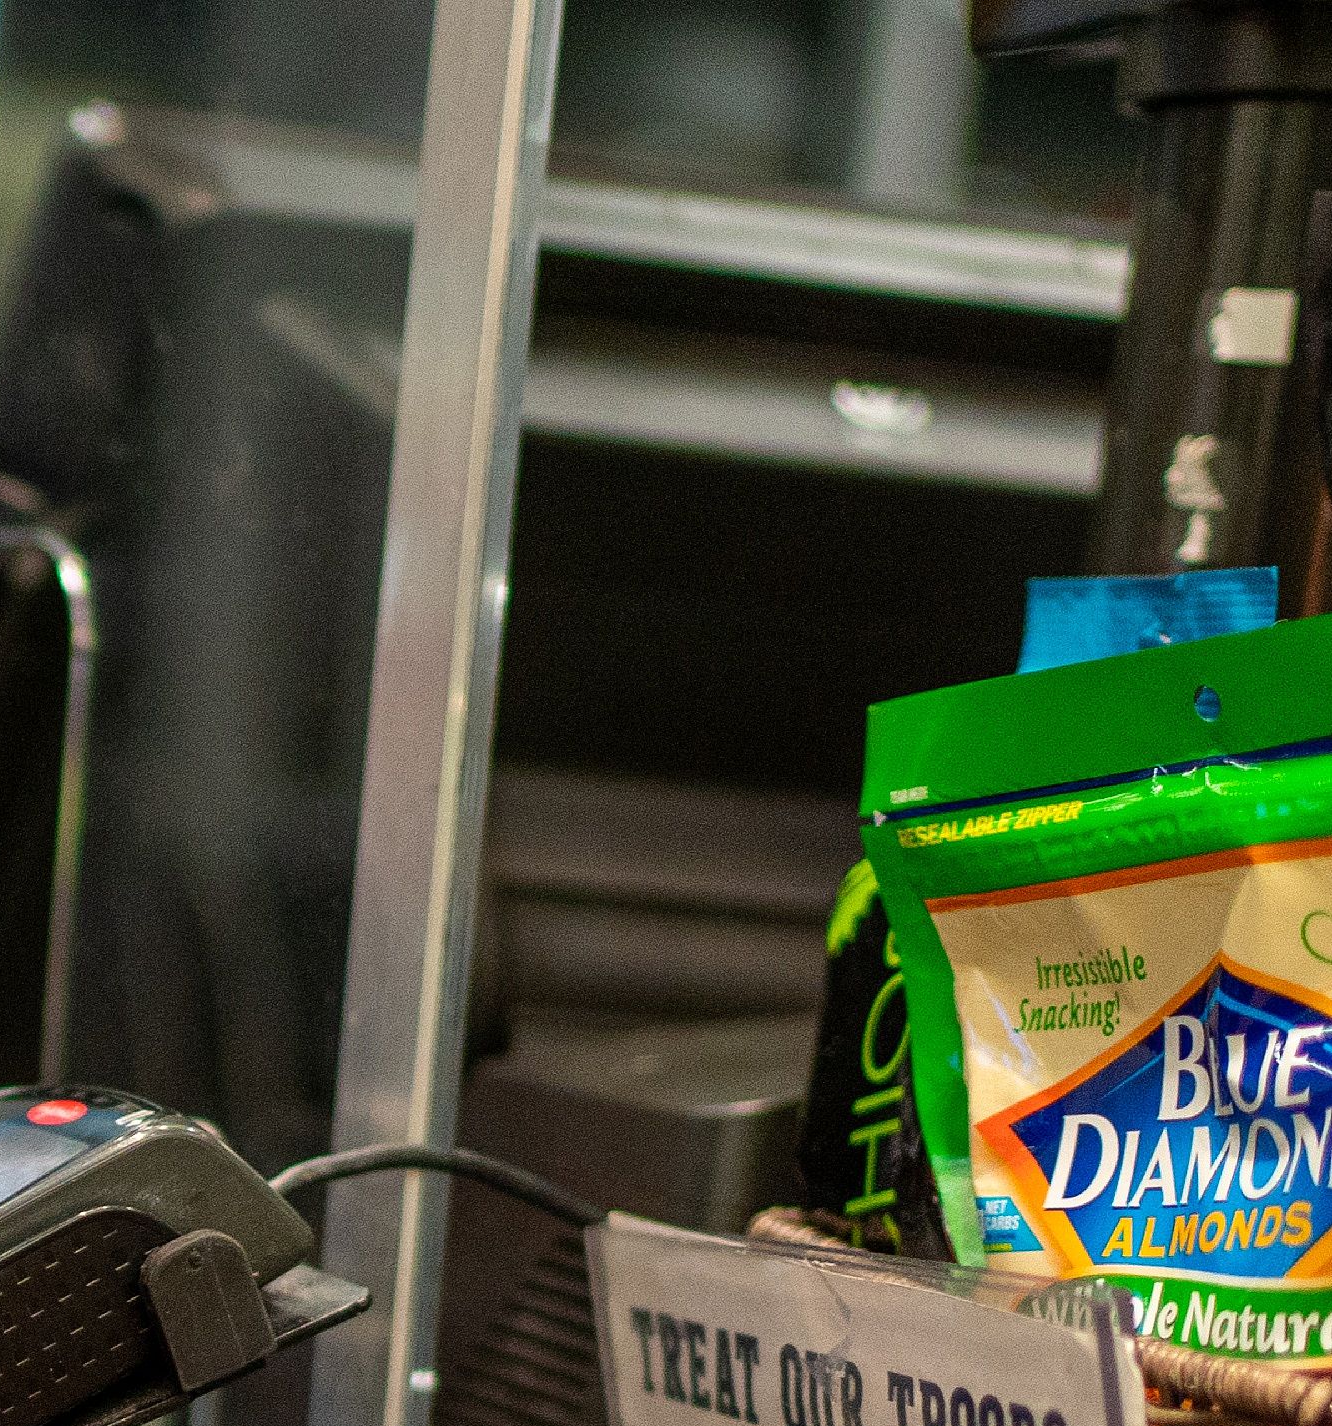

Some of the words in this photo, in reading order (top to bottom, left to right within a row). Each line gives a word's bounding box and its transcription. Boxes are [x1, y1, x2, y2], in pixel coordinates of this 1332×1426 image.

[1013, 801, 1084, 830] ZIPPER
[1036, 945, 1147, 989] Irresistible
[1014, 992, 1121, 1037] Snacking!
[1158, 1016, 1325, 1120] BLUE
[1044, 1107, 1332, 1211] DIAMON
[1101, 1200, 1314, 1259] ALMONDS
[631, 1306, 761, 1425] TREAT
